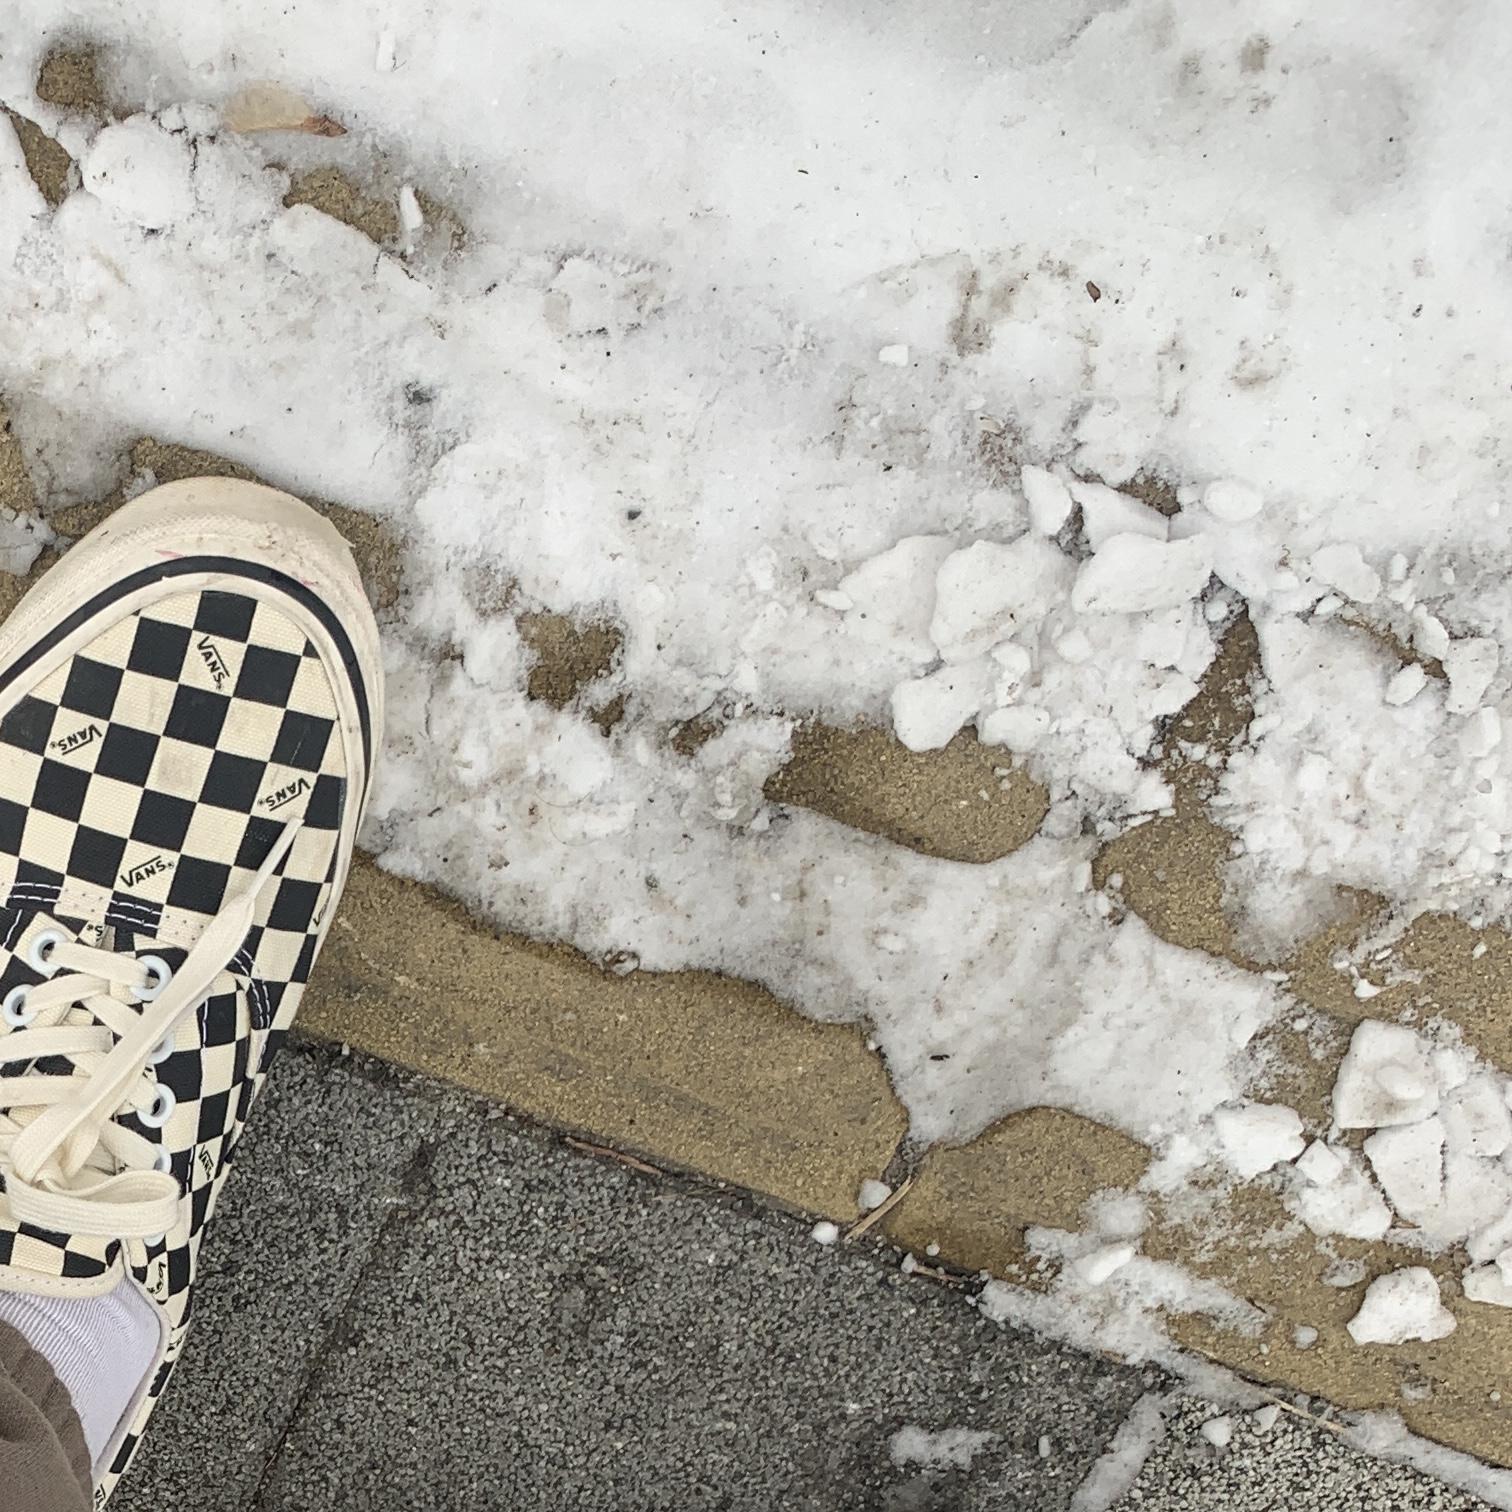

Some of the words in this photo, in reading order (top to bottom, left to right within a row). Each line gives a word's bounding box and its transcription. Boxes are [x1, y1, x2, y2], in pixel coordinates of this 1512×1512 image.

[196, 636, 230, 686] VANS
[57, 724, 103, 755] VANS
[265, 778, 311, 812] VANS
[120, 856, 168, 888] VANS
